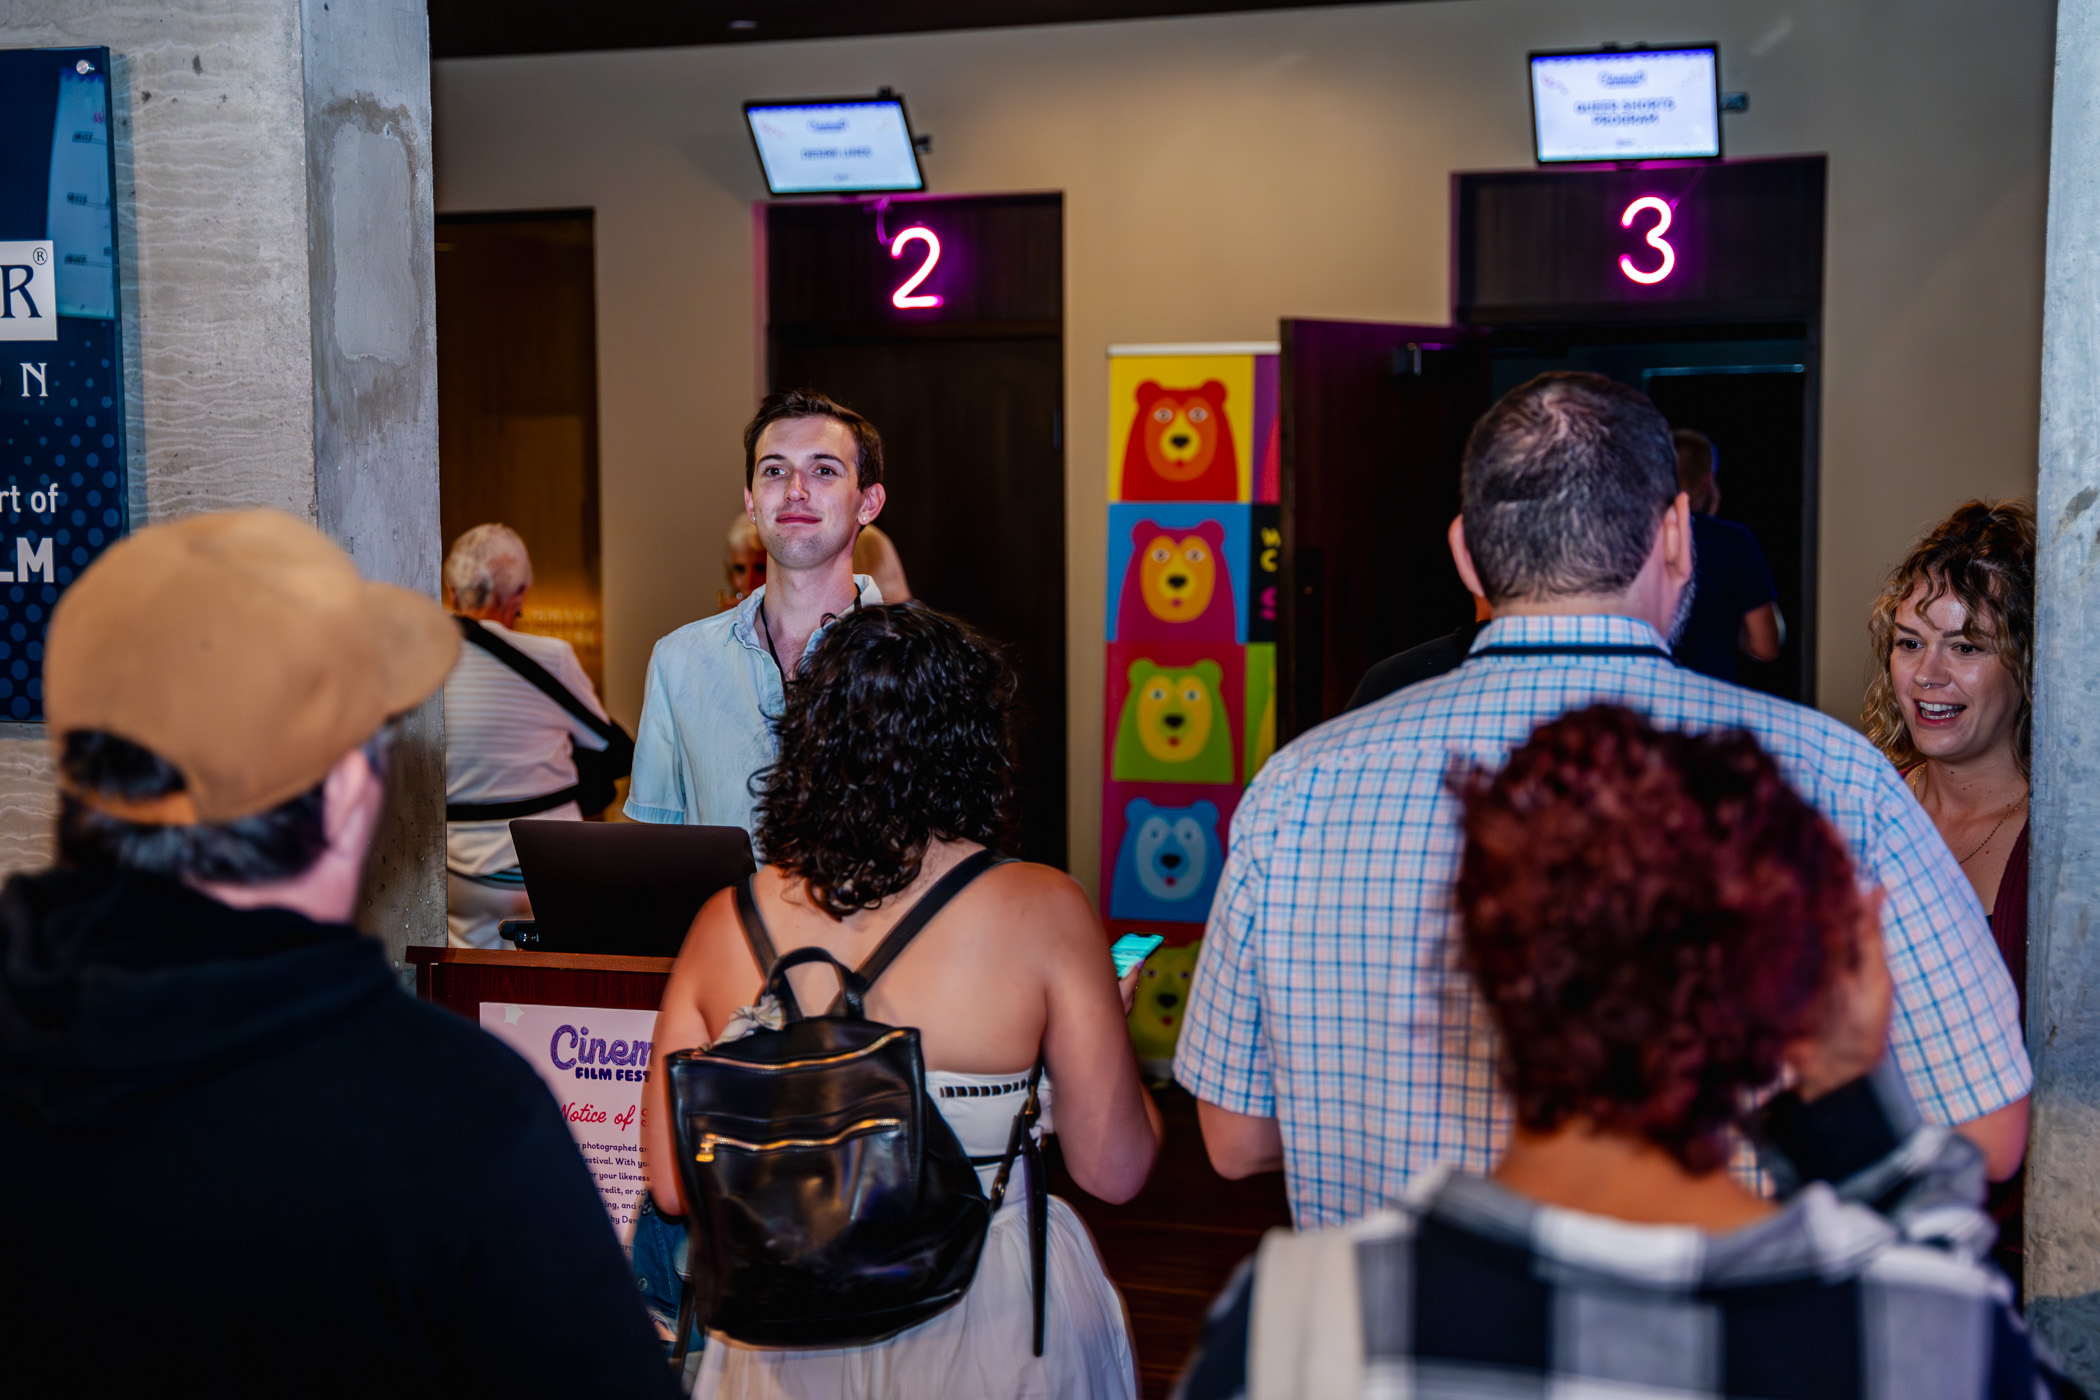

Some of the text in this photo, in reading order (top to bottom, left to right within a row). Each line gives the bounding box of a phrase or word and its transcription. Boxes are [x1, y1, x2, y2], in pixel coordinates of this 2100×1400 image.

[1618, 196, 1676, 284] 3
[891, 226, 944, 309] 2
[30, 482, 58, 513] of
[575, 1067, 612, 1081] FILM
[561, 1102, 607, 1123] Notice
[614, 1105, 636, 1132] of
[582, 1141, 637, 1154] photographed
[615, 1157, 636, 1167] With
[619, 1172, 651, 1182] likeness
[621, 1202, 637, 1210] and
[610, 1215, 620, 1225] by
